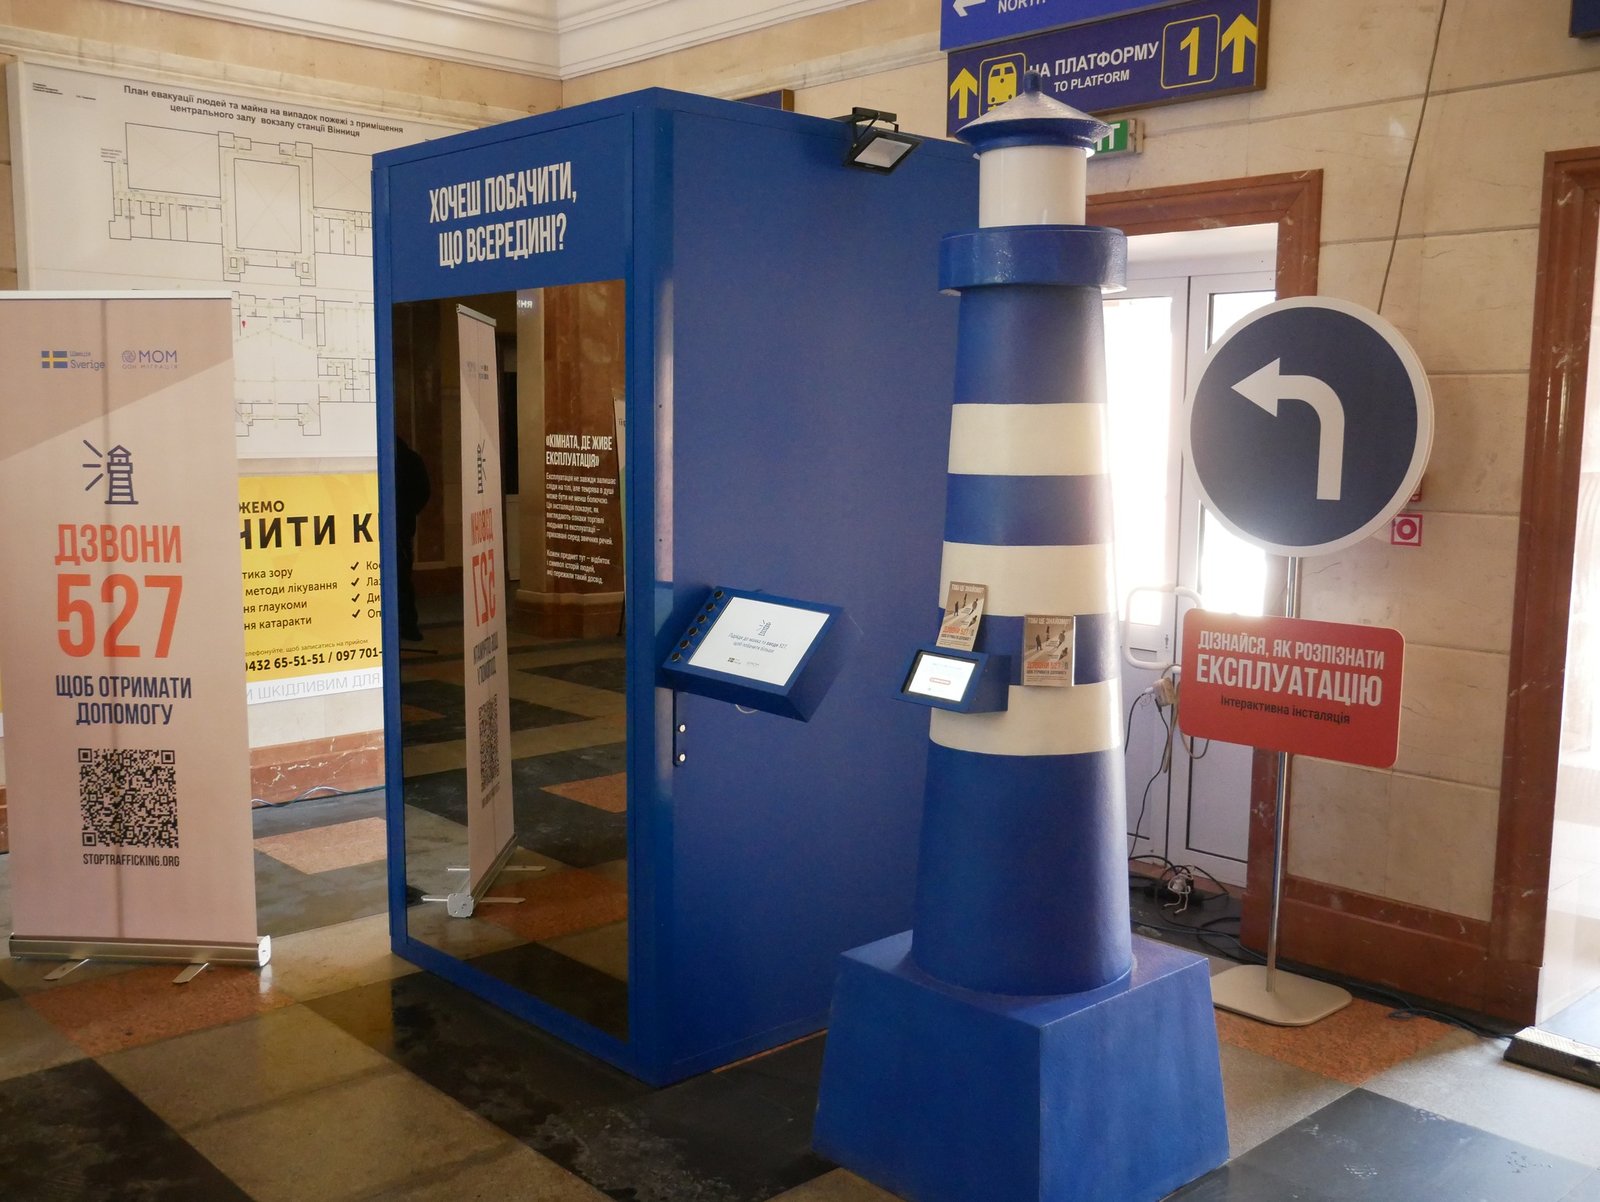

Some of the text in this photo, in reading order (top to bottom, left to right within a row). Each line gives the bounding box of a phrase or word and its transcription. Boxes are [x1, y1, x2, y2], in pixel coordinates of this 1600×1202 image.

[1055, 41, 1159, 76] ПЛАТФОРМУ
[1180, 26, 1199, 76] 1
[1054, 70, 1130, 92] TO PLATFORM
[124, 85, 148, 96] План
[152, 90, 194, 103] евакуації
[196, 96, 226, 108] людей
[229, 102, 238, 110] та
[241, 103, 268, 114] майна
[282, 110, 318, 121] випадок
[320, 116, 348, 126] пожежі
[356, 120, 404, 134] приміщення
[170, 104, 360, 138] центрального залу вокзалу станції Вінниця
[429, 161, 577, 224] ХОЧЕШ ПОБАЧИТИ,
[439, 212, 567, 269] ЩО ВСЕРЕДИНІ?
[70, 360, 106, 370] Sverige
[581, 436, 590, 450] ДЕ
[592, 436, 612, 450] ЖИВЕ
[546, 451, 600, 468] ЕКСПЛУАТАЦІЯ»
[353, 513, 373, 543] К
[54, 524, 182, 566] ДЗВОНИ
[269, 568, 293, 580] зору
[246, 581, 337, 596] методи лікування
[57, 574, 182, 658] 527
[258, 600, 308, 614] глаукоми
[259, 616, 312, 630] катаракти
[274, 653, 325, 669] 65-51-51
[336, 650, 356, 662] 097
[1198, 630, 1384, 670] ДІЗНАЙСЯ, ЯК РОЗПІЗНАТИ
[56, 675, 192, 698] ЩОБ ОТРИМАТИ
[258, 677, 348, 700] ШКІДЛИВИМ
[352, 672, 380, 688] ДЛЯ
[1196, 654, 1382, 707] ЕКСПЛУАТАЦІЮ
[76, 703, 173, 726] ДОПОМОГУ
[1221, 696, 1350, 724] Інтерактивна інсталяція
[83, 854, 180, 866] STOPTRAFFICKING.ORG
